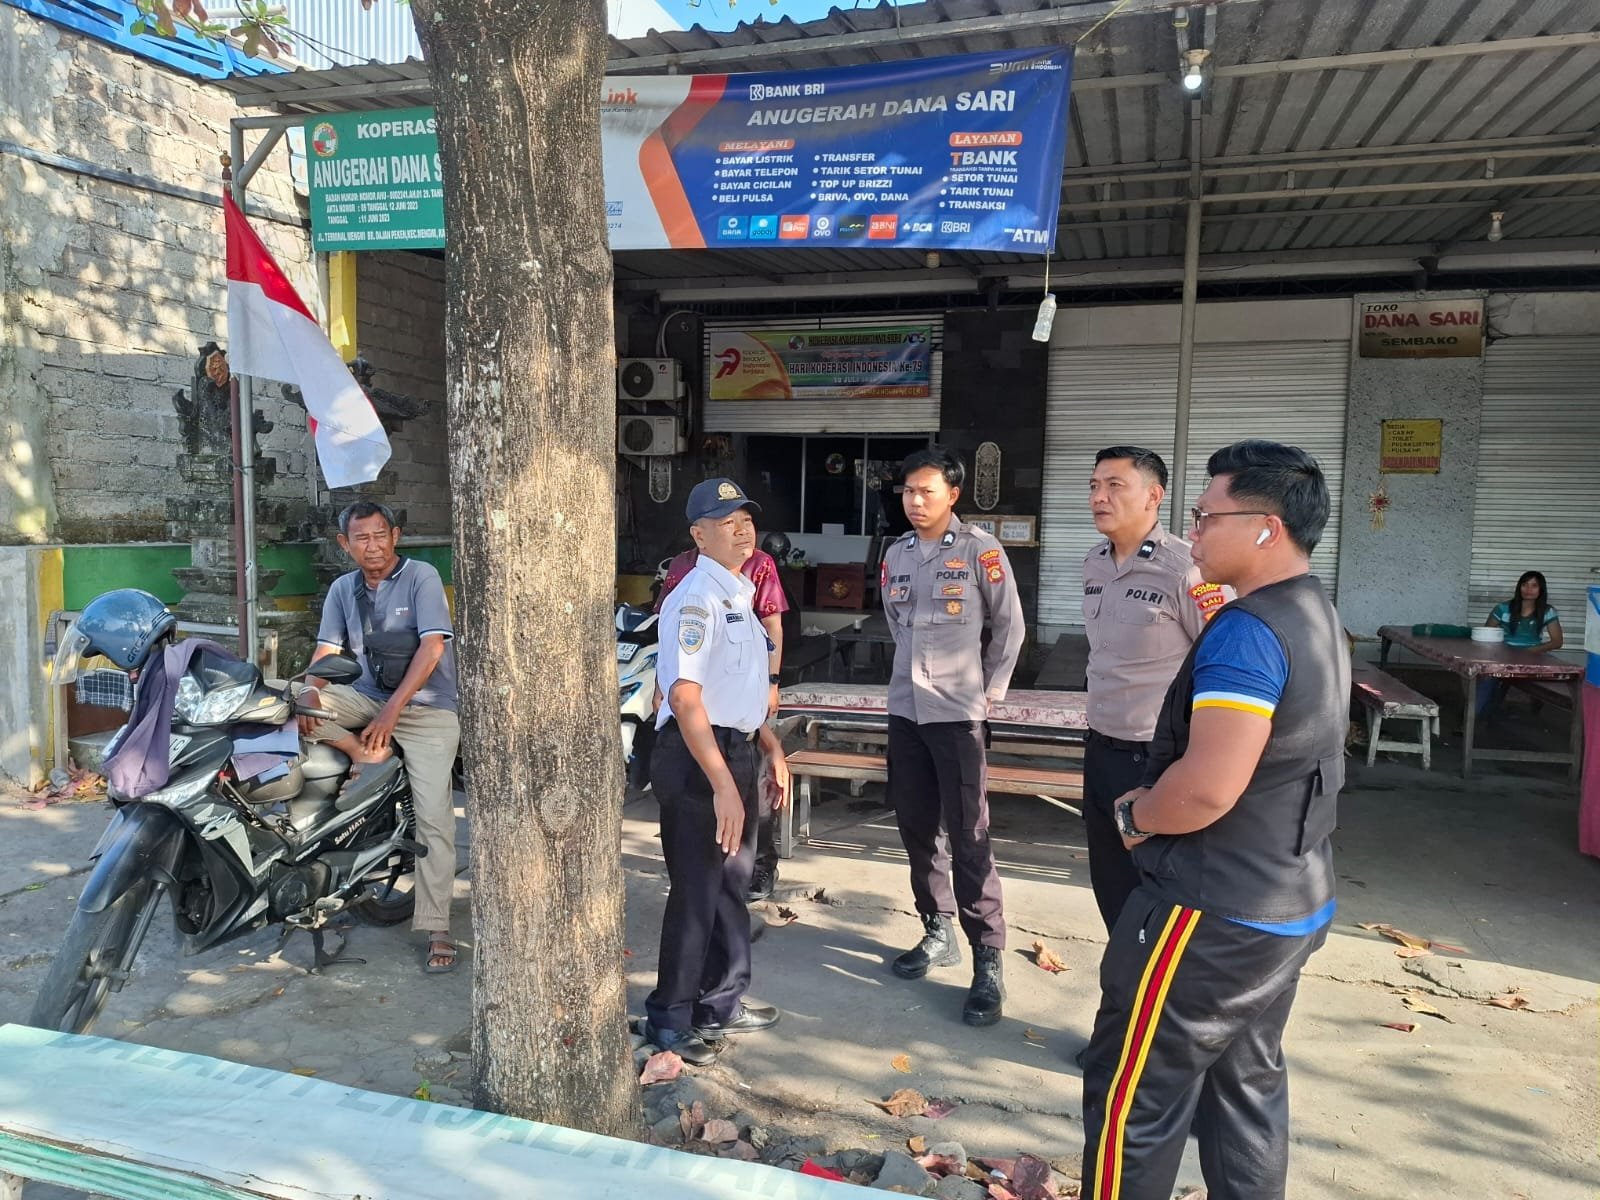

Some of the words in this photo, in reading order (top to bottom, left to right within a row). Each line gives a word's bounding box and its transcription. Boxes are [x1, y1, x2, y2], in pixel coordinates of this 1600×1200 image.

[765, 85, 800, 98] BANK
[804, 83, 825, 96] BRI
[601, 87, 638, 105] ink
[747, 103, 877, 126] ANUGERAH
[882, 95, 948, 116] DANA
[955, 90, 1015, 112] SARI
[357, 118, 437, 139] KOPERAS
[954, 132, 1017, 145] LAYANAN
[724, 140, 789, 150] MELAYANI
[722, 157, 753, 165] BAYAR
[755, 155, 794, 164] LISTRIK
[822, 153, 876, 162] TRANSFER
[950, 151, 1019, 166] TBANK
[313, 156, 388, 188] ANUGERAH
[391, 154, 431, 184] DANA
[434, 153, 443, 182] S
[721, 170, 752, 178] BAYAR
[754, 167, 798, 176] TELEPON
[821, 167, 851, 175] TARIK
[853, 166, 887, 175] SETOR
[890, 166, 923, 175] TUNAI
[819, 180, 839, 188] TOP
[842, 180, 856, 188] UP
[859, 180, 893, 188] BRIZZI
[951, 174, 984, 183] SETOR
[987, 174, 1018, 184] TUNAI
[720, 182, 751, 190] BAYAR
[753, 180, 792, 189] CICILAN
[950, 187, 980, 196] TARIK
[982, 187, 1014, 197] TUNAI
[719, 194, 740, 203] BELI
[742, 193, 773, 202] PULSA
[818, 193, 851, 202] BRIVA,
[853, 193, 878, 203] OVO,
[880, 193, 909, 201] DANA
[949, 200, 1006, 210] TRANSAKSI
[880, 222, 896, 231] BNI
[911, 222, 933, 232] BCA
[953, 222, 971, 233] BRI
[814, 229, 831, 237] OVO
[1012, 229, 1048, 243] ATM
[1367, 304, 1398, 312] TOKO
[1365, 313, 1420, 328] DANA
[1430, 311, 1479, 326] SARI
[1381, 336, 1458, 346] SEMBAKO
[789, 362, 808, 374] HARI
[808, 361, 849, 374] KOPERASI
[852, 360, 897, 373] INDONESIA
[936, 571, 969, 581] POLRI
[1125, 588, 1163, 604] POLRI
[1201, 597, 1222, 607] BALI
[334, 830, 350, 845] Satu
